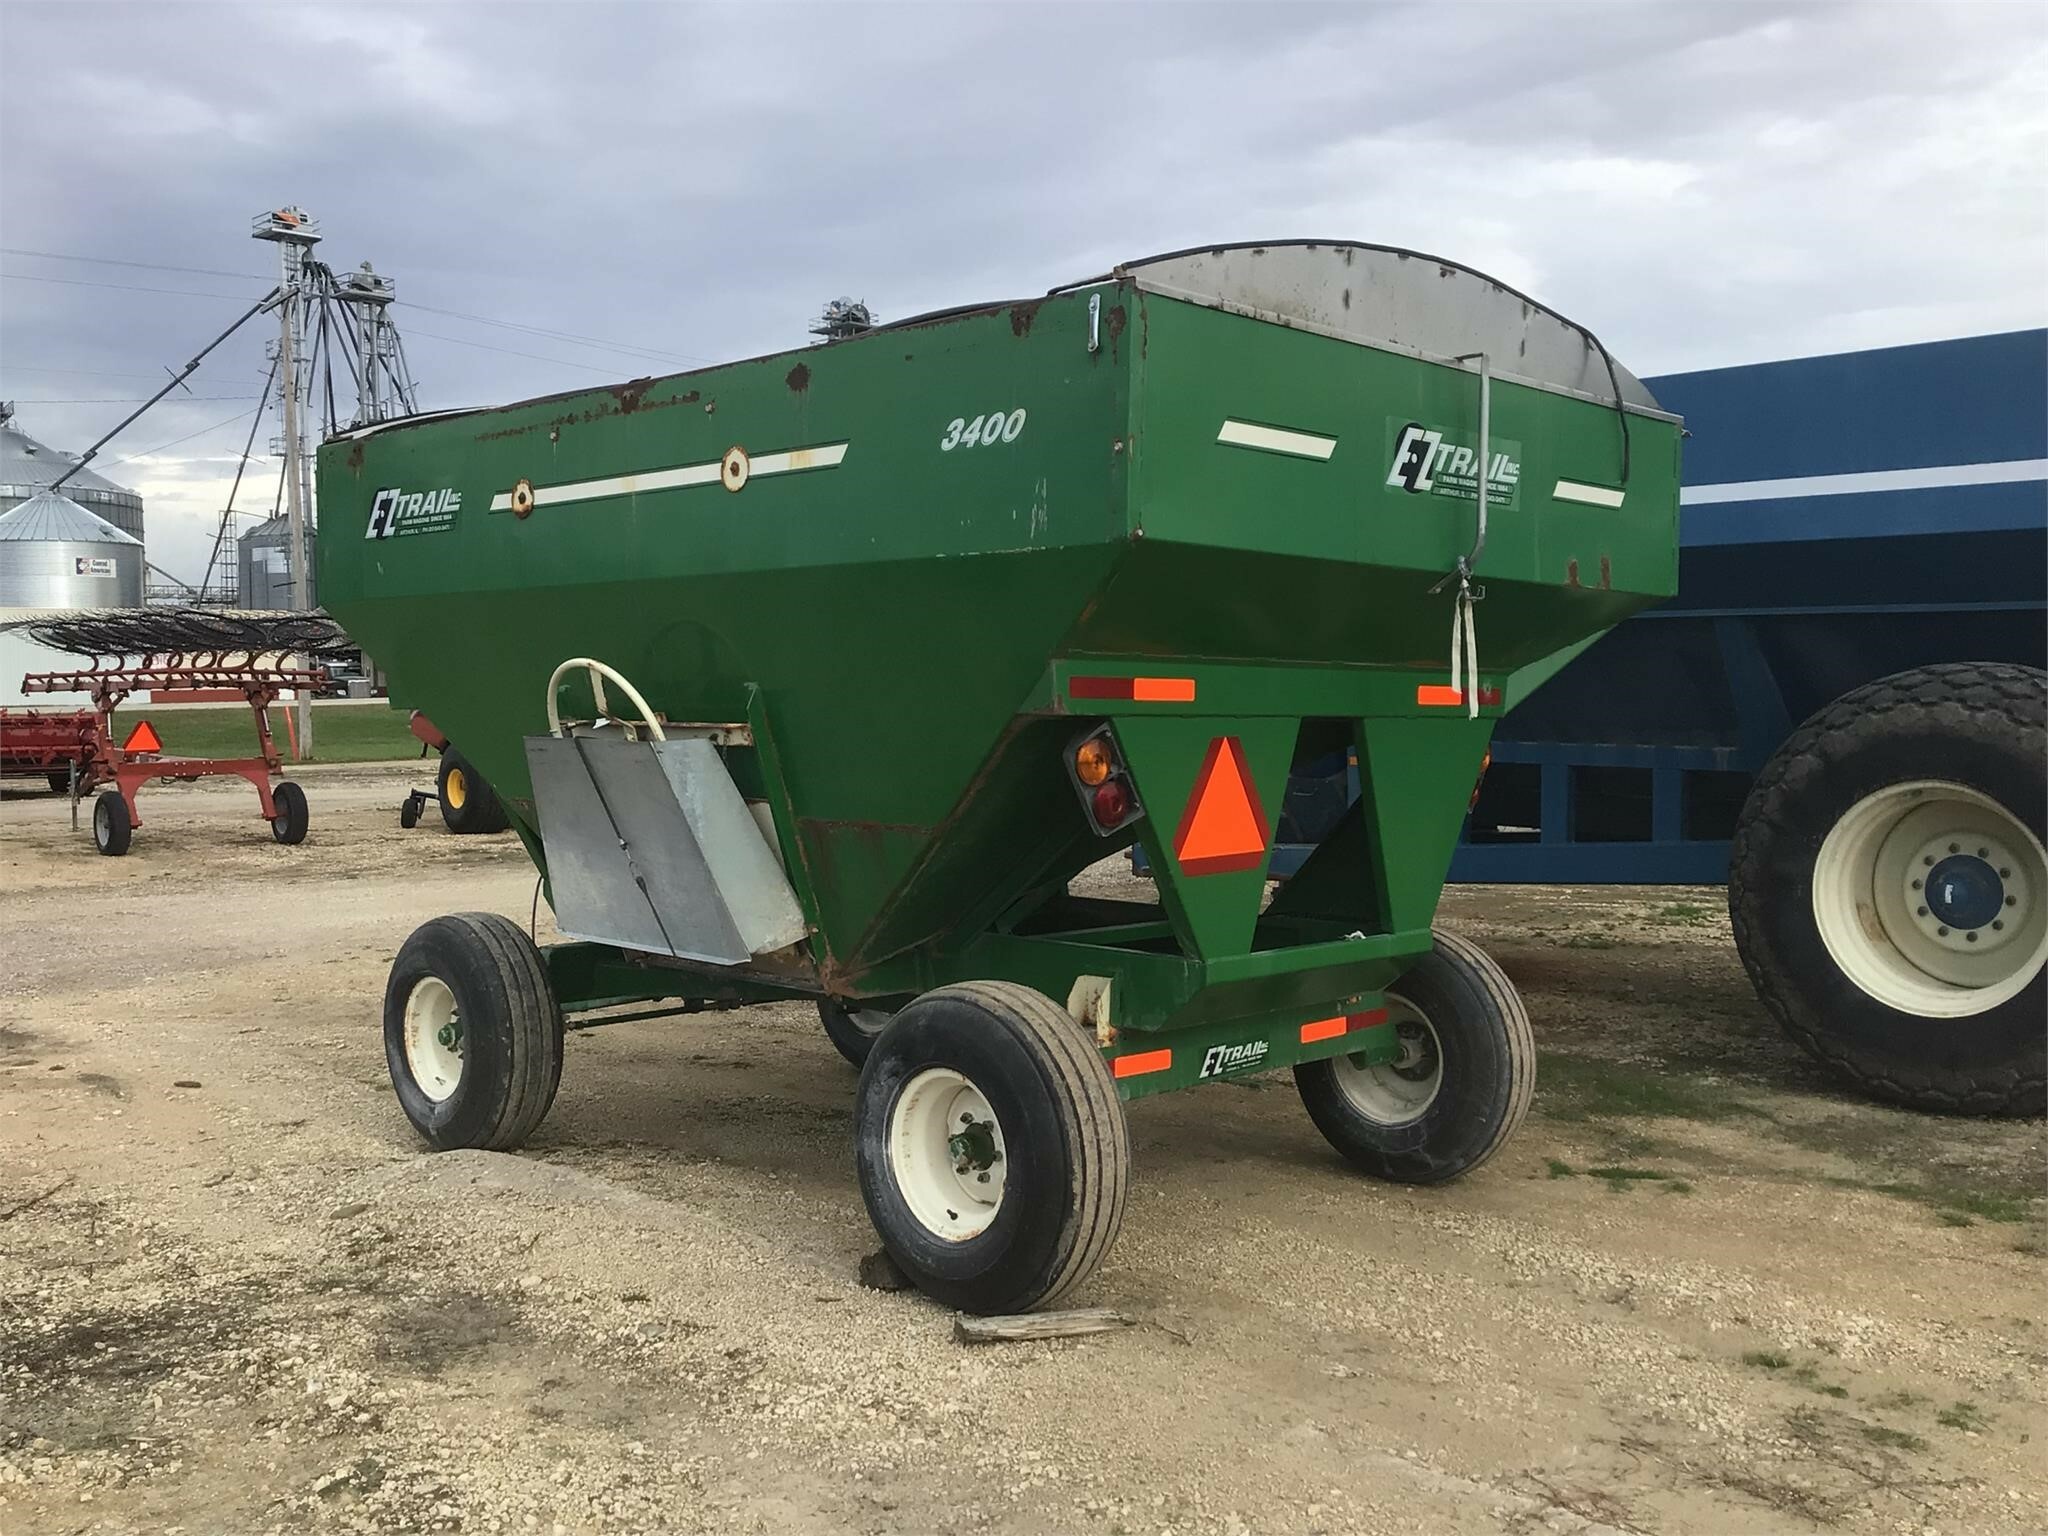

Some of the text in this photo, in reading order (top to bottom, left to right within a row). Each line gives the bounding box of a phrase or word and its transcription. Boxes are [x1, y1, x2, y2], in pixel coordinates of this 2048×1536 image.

[941, 408, 1027, 451] 3400
[1386, 426, 1443, 491] EZ
[365, 488, 401, 539] EZ
[396, 488, 460, 519] TRAIL
[1199, 1044, 1227, 1079] EZ
[1223, 1040, 1268, 1063] TRAIL
